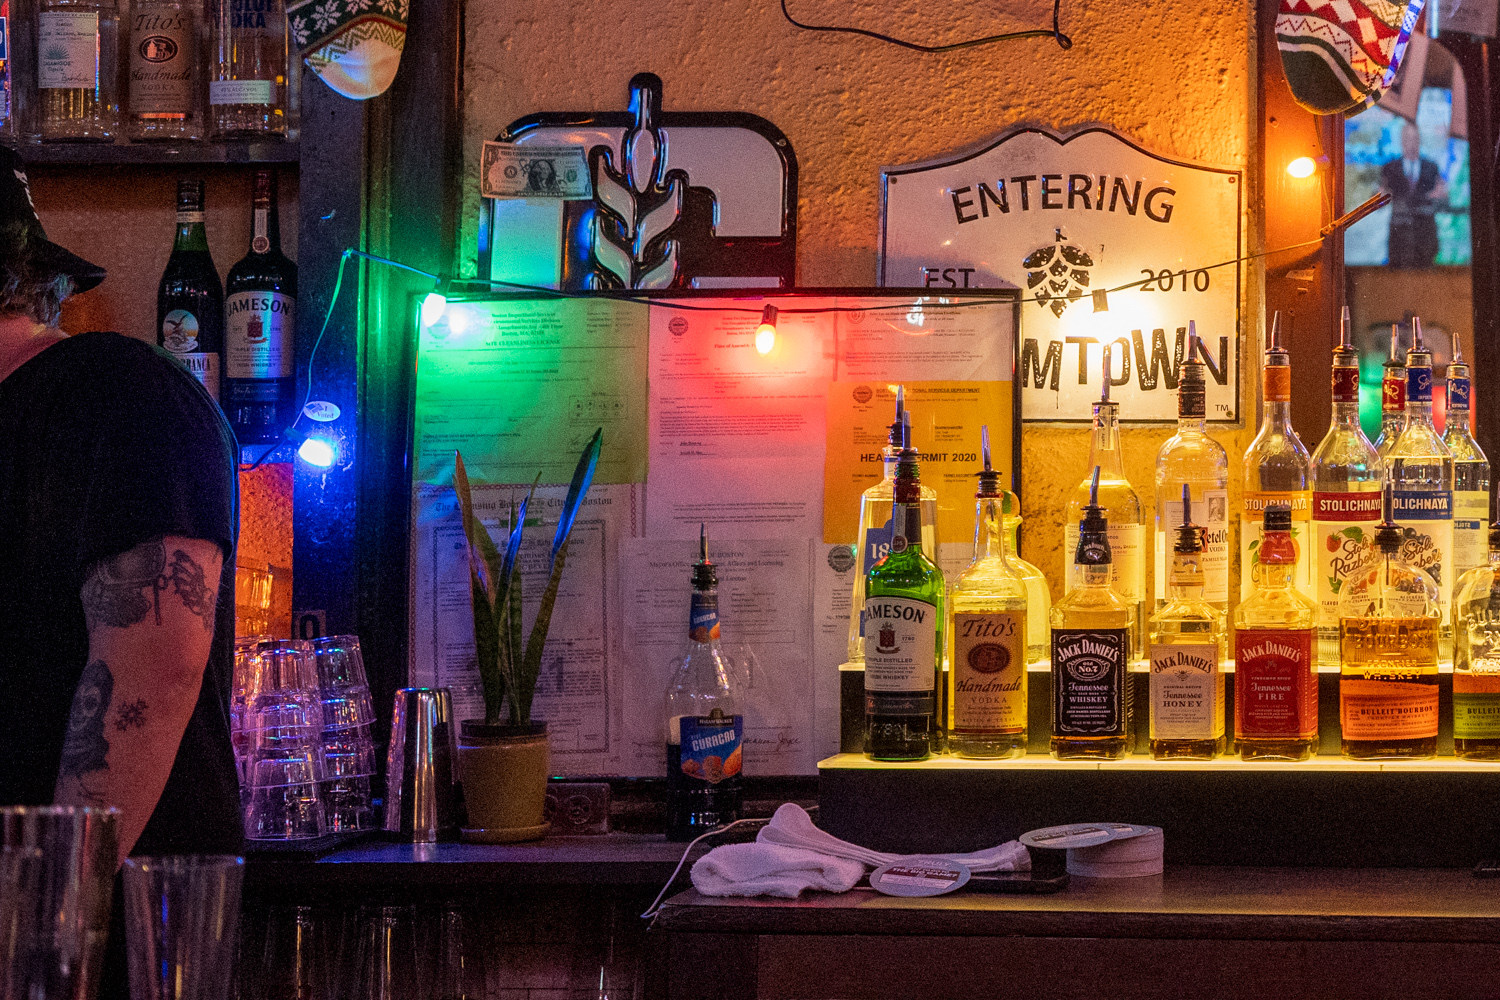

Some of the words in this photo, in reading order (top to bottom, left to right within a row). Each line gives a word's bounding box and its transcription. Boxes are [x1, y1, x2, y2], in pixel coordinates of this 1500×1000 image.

[135, 13, 186, 31] Tito's
[951, 173, 1176, 225] ENTERING
[1139, 268, 1211, 292] 2010
[227, 298, 291, 317] JAMESON
[860, 453, 883, 462] HEA
[917, 453, 948, 462] ERMIT
[952, 452, 977, 462] 2020
[1320, 499, 1381, 512] STOLICHNAYA
[865, 604, 925, 624] JAMESON
[962, 618, 1016, 638] Tito's
[1057, 643, 1081, 662] JACK
[1082, 639, 1120, 663] DANIEL'S
[1242, 644, 1265, 663] JACK
[1266, 640, 1302, 663] DANIEL'S
[1154, 656, 1176, 674] JACK
[1177, 651, 1214, 674] DANIEL'S
[956, 676, 1022, 693] Handmade
[1068, 682, 1109, 692] Tennessee
[1251, 682, 1292, 692] Tennessee
[1163, 690, 1202, 699] Tennessee
[1258, 693, 1285, 701] FIRE
[1163, 700, 1203, 708] HONEY
[1398, 705, 1434, 714] BOURBON
[1467, 707, 1500, 715] BULLEIT
[691, 729, 736, 752] CURACAO
